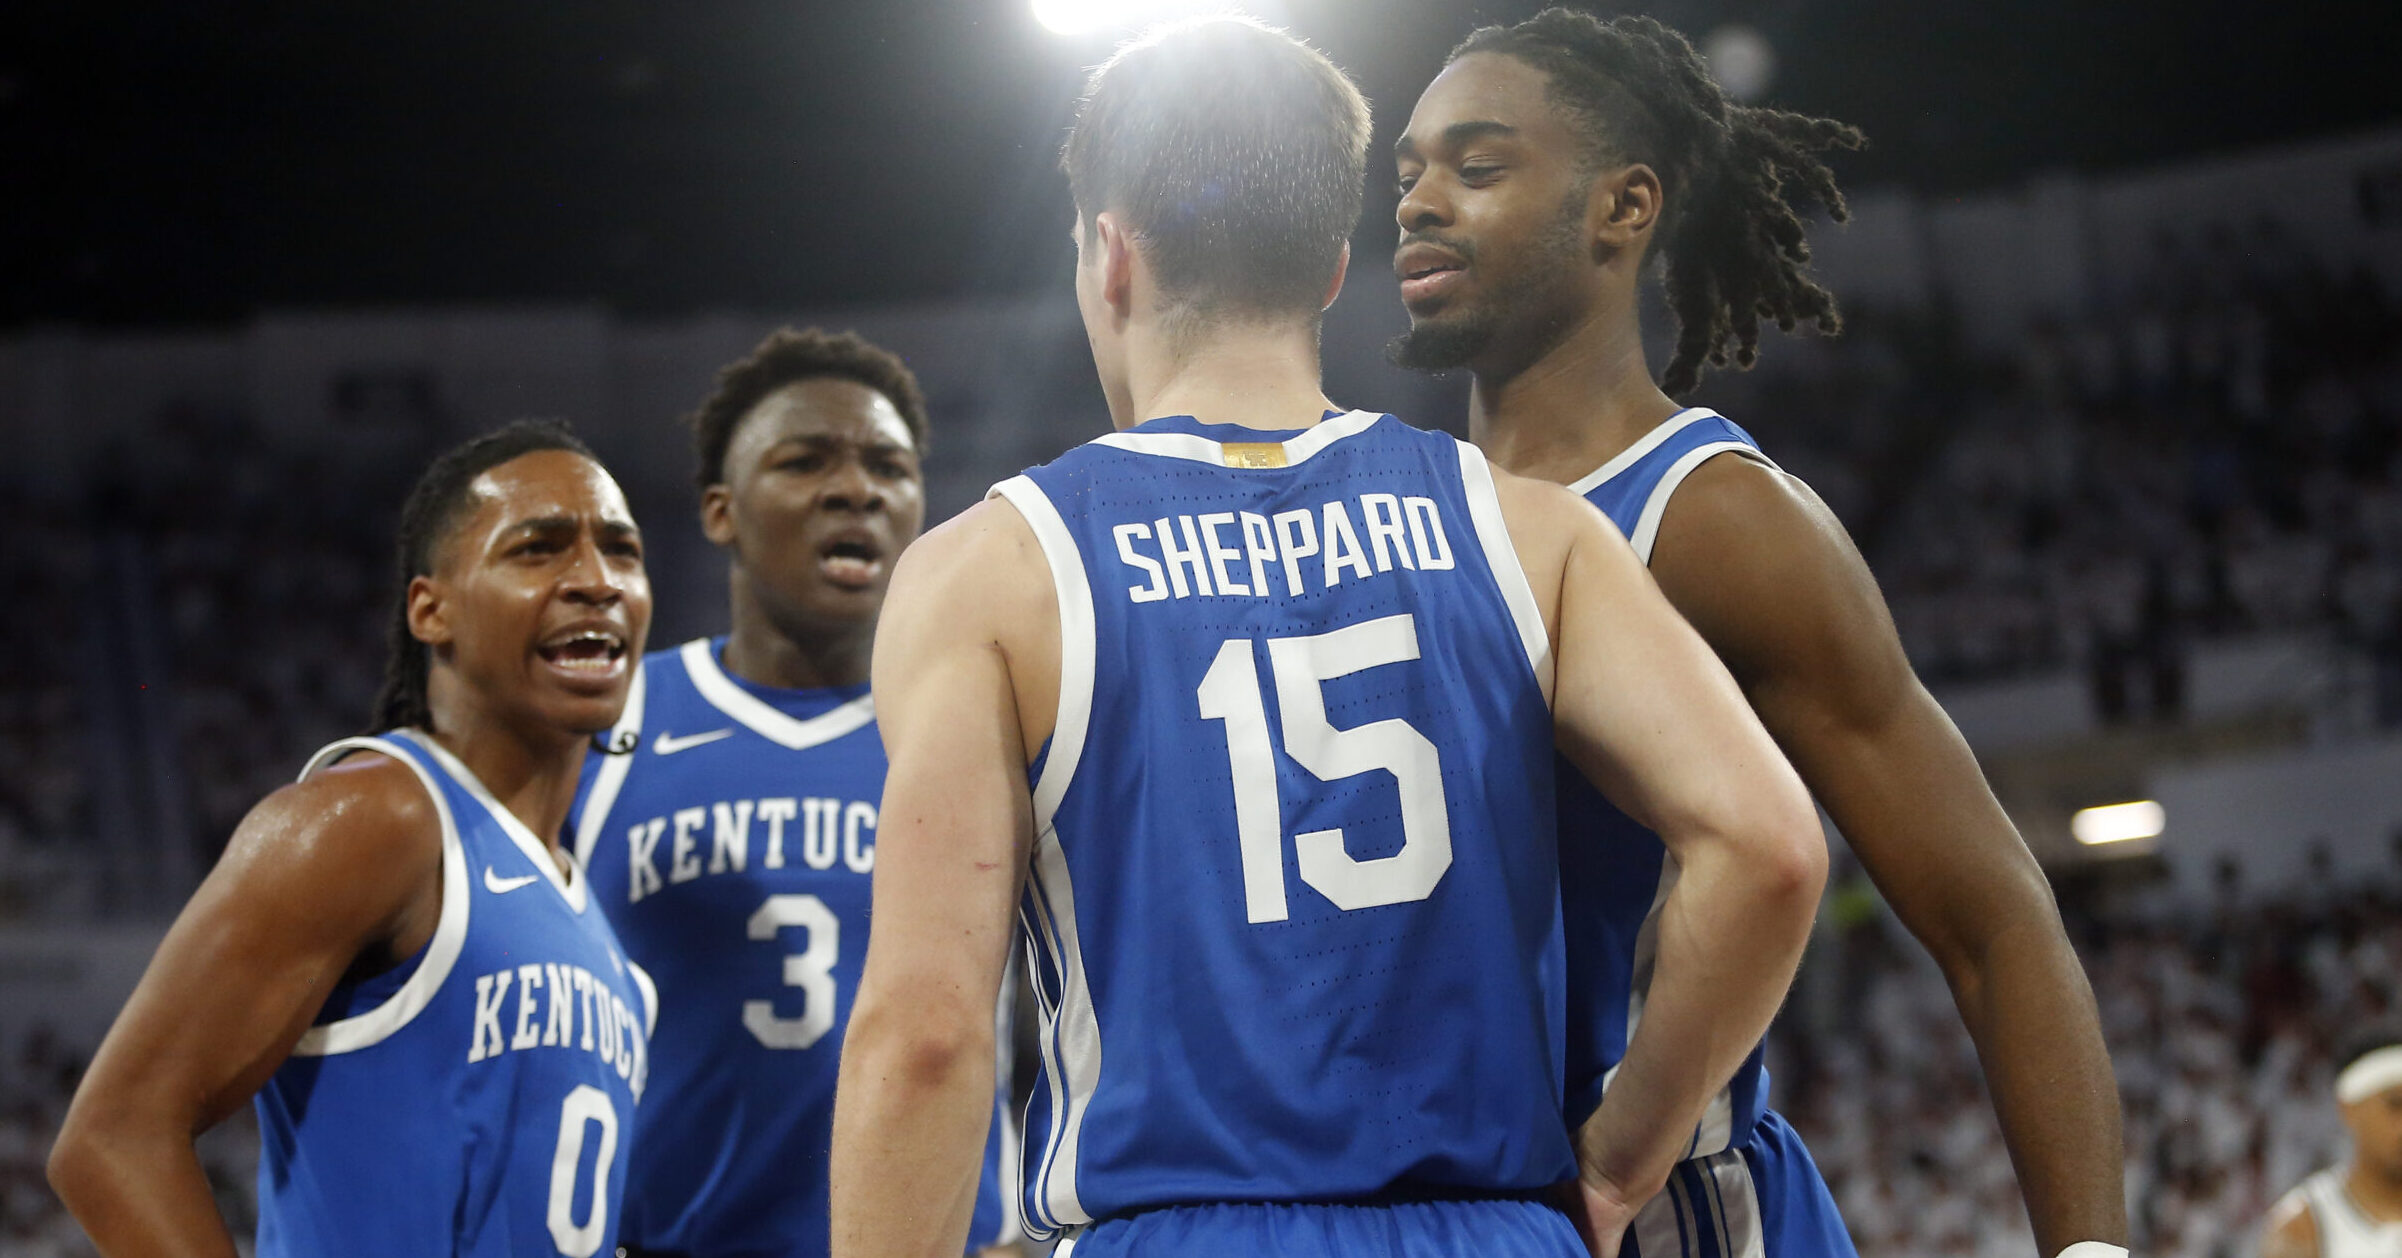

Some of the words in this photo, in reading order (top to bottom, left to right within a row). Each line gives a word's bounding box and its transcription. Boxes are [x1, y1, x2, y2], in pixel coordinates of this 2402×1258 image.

[1112, 493, 1455, 603] SHEPPARD
[1197, 613, 1454, 923] 15
[628, 797, 877, 903] KENTUC
[742, 894, 840, 1050] 3
[546, 1083, 618, 1258] 0
